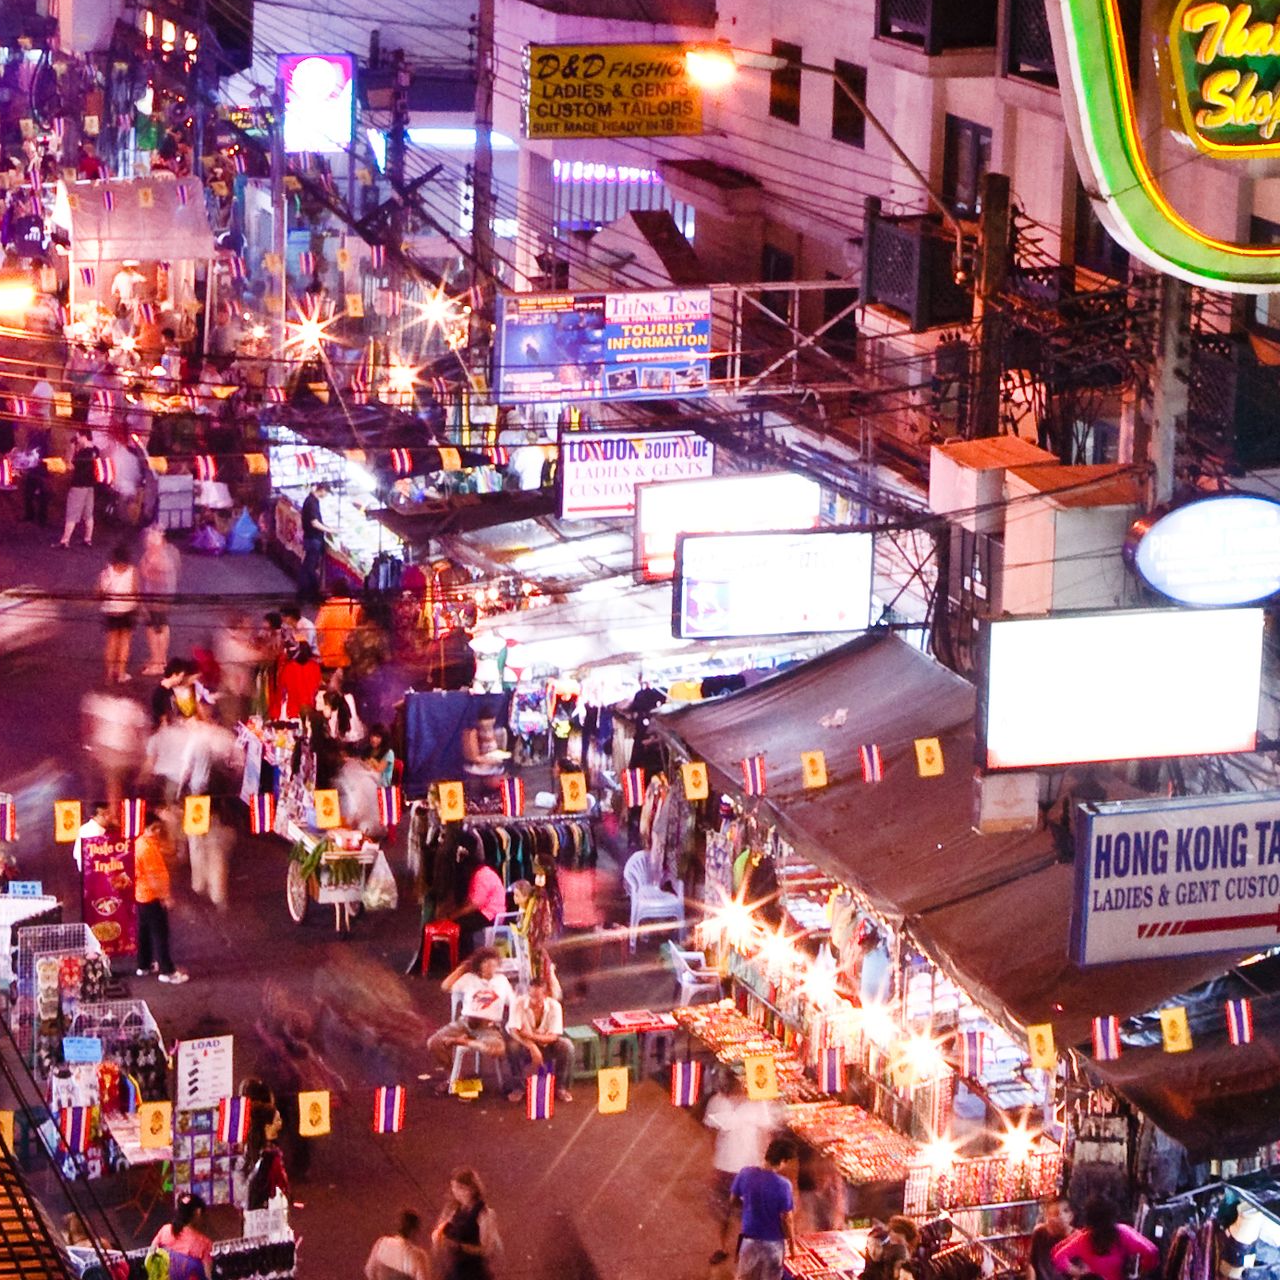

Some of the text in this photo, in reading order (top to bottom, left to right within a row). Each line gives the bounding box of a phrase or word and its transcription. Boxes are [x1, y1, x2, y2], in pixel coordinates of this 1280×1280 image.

[542, 81, 690, 100] LADIES & GENTS
[536, 99, 694, 118] CUSTOM TAILORS
[532, 122, 560, 133] SUIT
[563, 121, 599, 133] MADE
[621, 321, 696, 337] TOURIST
[607, 334, 708, 350] INFORMATION
[575, 462, 703, 480] LADIES & GENTS
[1094, 829, 1169, 879] HONG
[1175, 822, 1248, 872] KONG
[1093, 886, 1154, 912] LADIES
[1158, 887, 1170, 906] &
[1175, 880, 1221, 905] GENT
